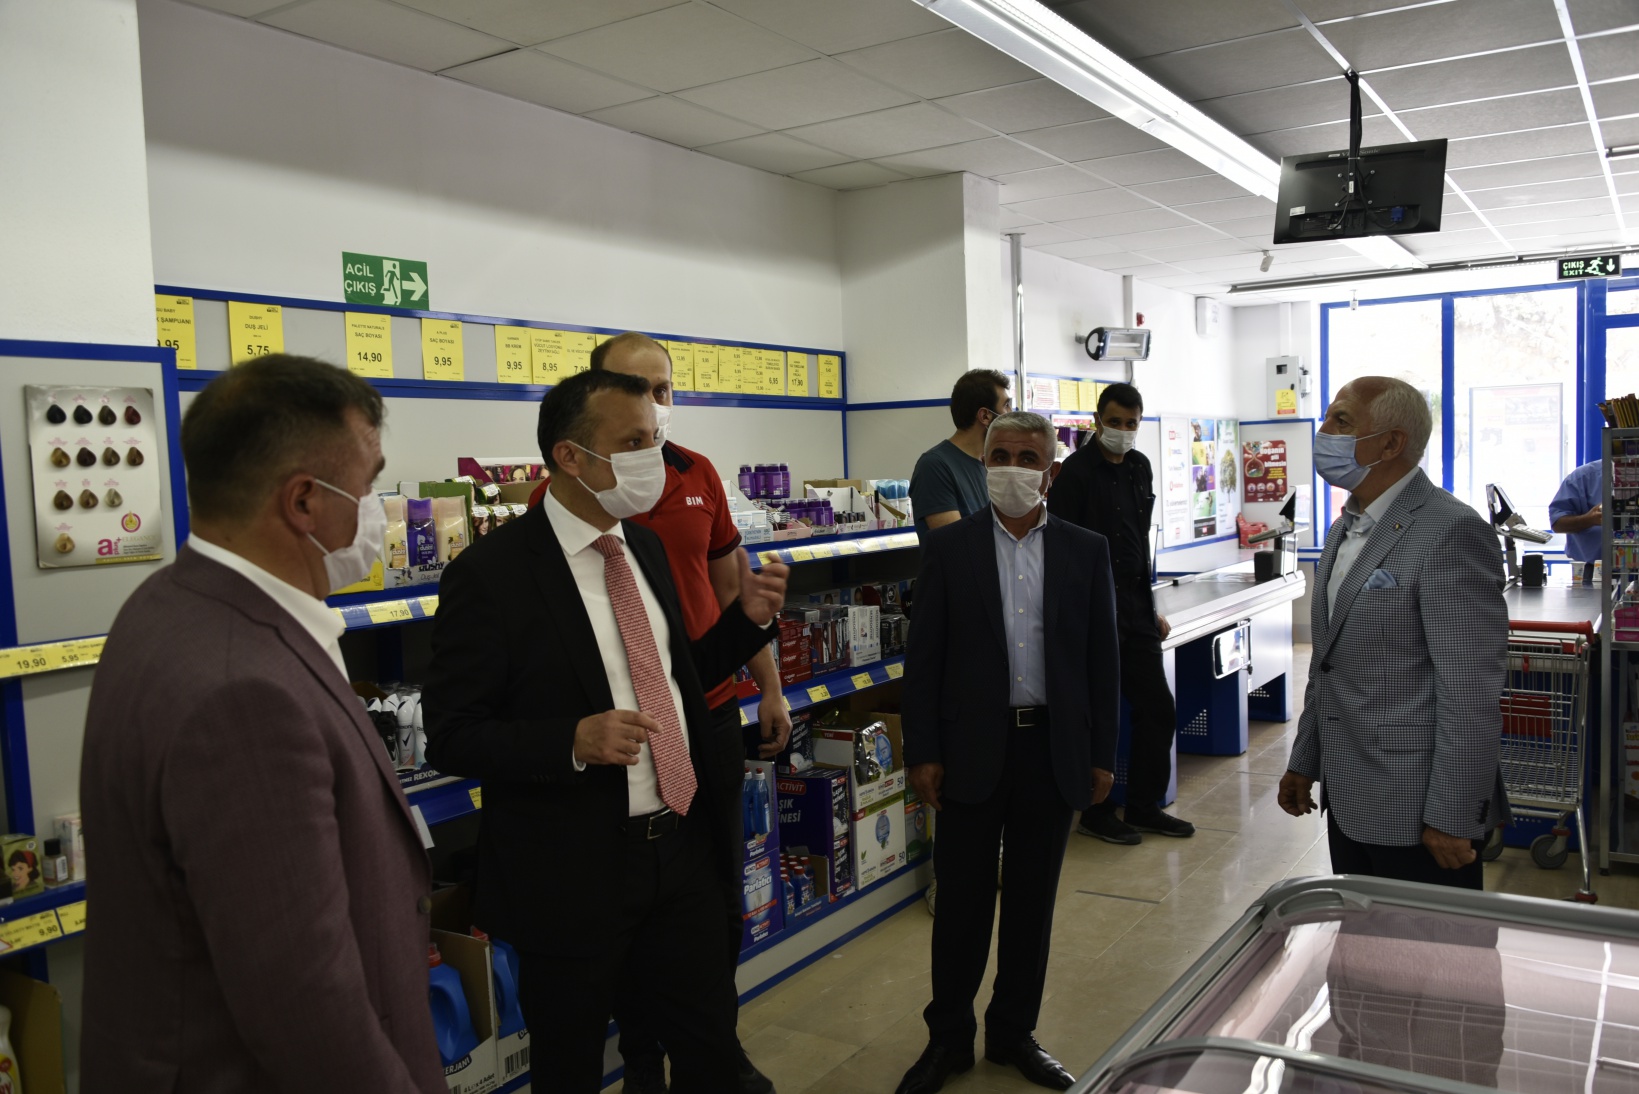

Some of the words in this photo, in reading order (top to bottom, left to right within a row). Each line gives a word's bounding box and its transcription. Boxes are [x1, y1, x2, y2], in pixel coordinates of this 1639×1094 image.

[345, 262, 374, 277] ACİL
[1562, 260, 1585, 271] ÇIKIŞ
[344, 279, 377, 296] ÇIKIŞ
[365, 331, 383, 339] BOYASI
[246, 344, 270, 357] 5,75
[357, 351, 382, 364] 14,90
[433, 356, 452, 368] 9,95
[506, 360, 523, 372] 9,95
[542, 362, 558, 373] 8,95
[768, 377, 779, 385] 6,95
[791, 378, 804, 387] 17,90
[390, 609, 410, 619] 17,90
[17, 657, 48, 671] 19,90
[62, 653, 80, 664] 5,95
[897, 776, 904, 786] 50
[898, 851, 906, 862] 50
[39, 924, 59, 937] 9,90
